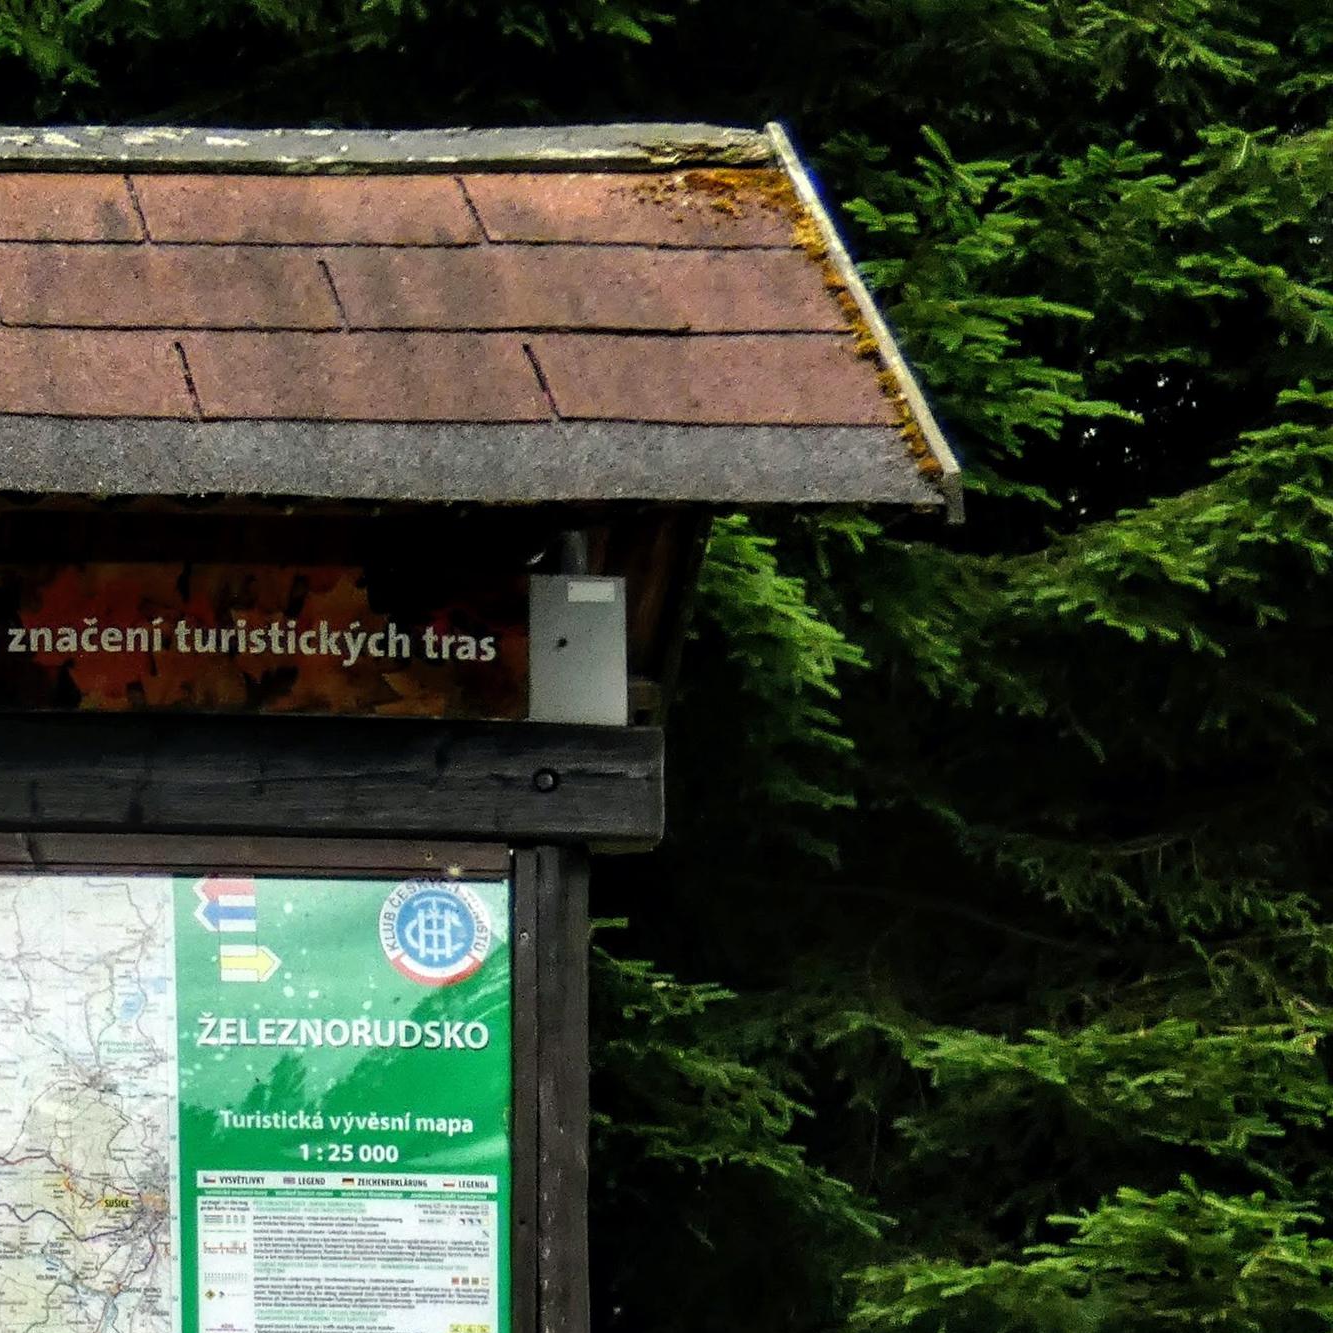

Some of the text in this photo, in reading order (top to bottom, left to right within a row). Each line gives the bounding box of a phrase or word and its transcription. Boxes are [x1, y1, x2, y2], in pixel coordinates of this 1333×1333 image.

[8, 617, 163, 653] značení
[175, 620, 410, 665] turistických
[422, 626, 496, 661] tras
[197, 1012, 490, 1050] ŽELEZNORUDSKO
[219, 1110, 473, 1135] Turistická vývěsní mapa
[299, 1144, 309, 1161] 1
[328, 1144, 354, 1161] 25
[359, 1145, 399, 1163] 000
[298, 1177, 326, 1187] LEGEND
[458, 1179, 490, 1189] LEGENDA
